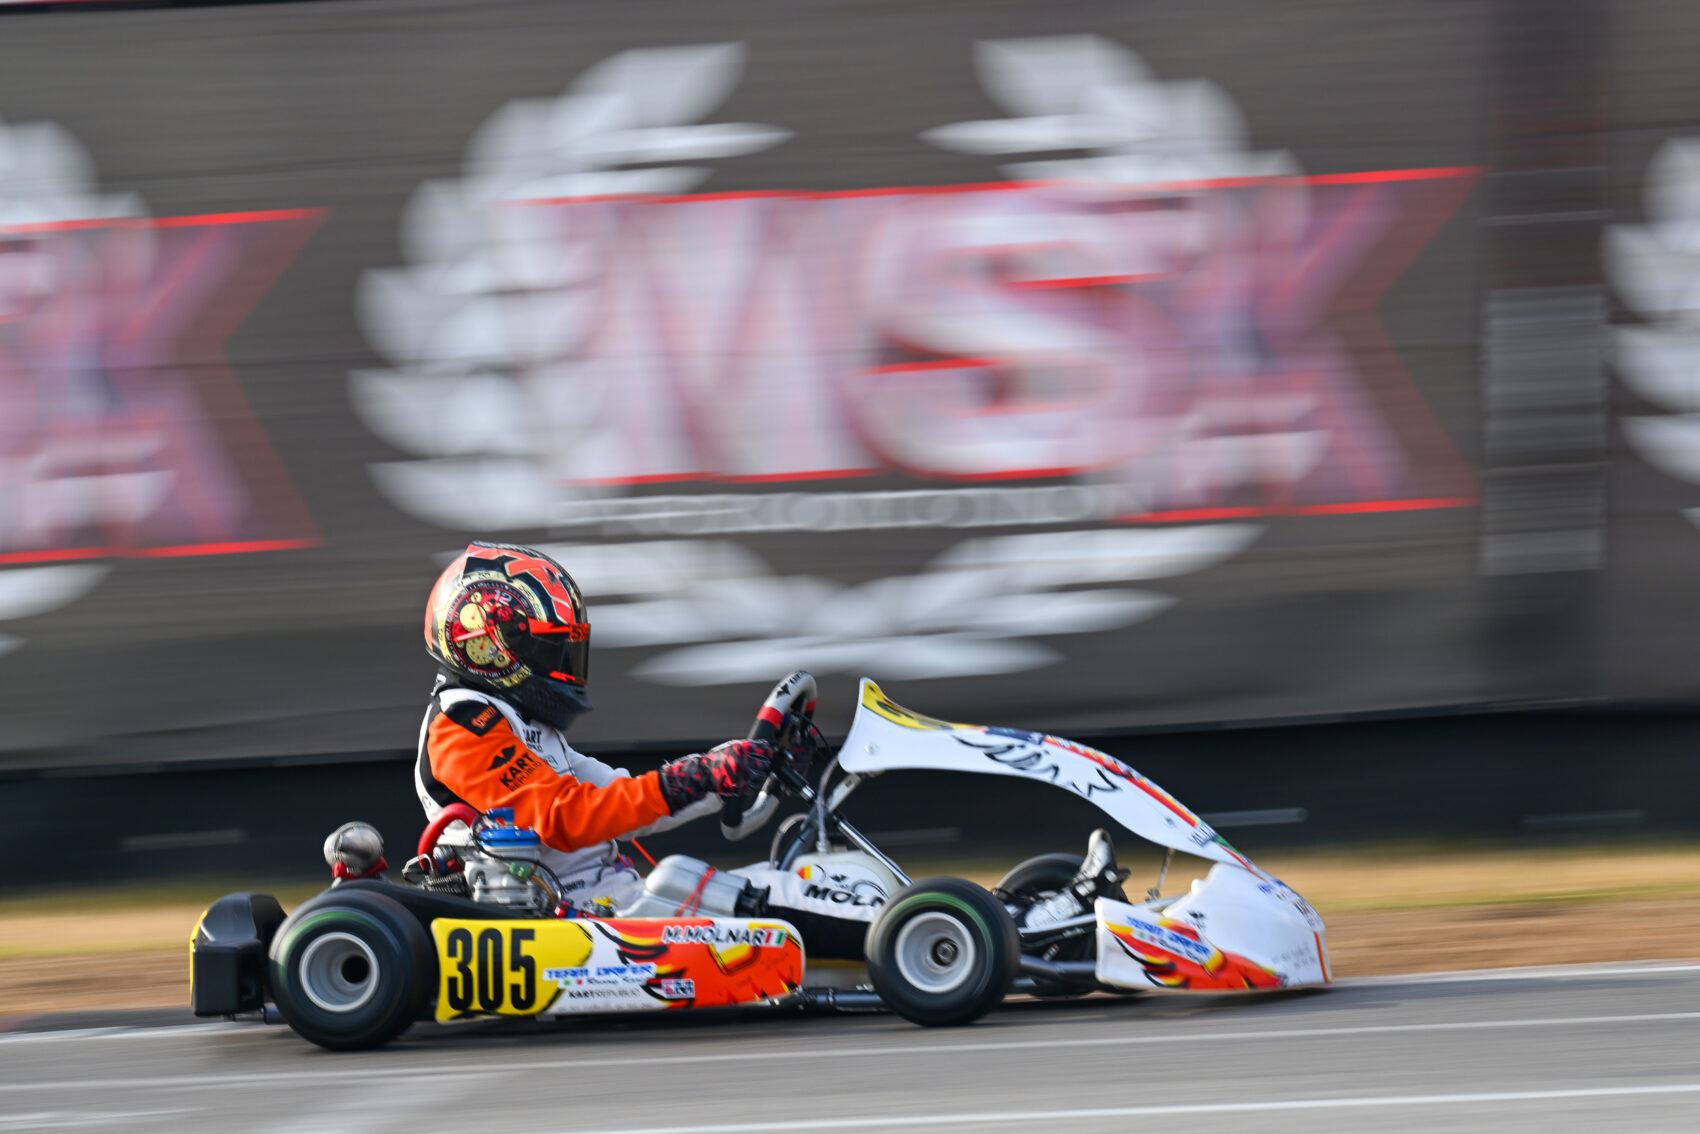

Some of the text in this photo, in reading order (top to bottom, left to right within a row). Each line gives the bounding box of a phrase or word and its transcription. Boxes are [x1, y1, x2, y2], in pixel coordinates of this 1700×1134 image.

[523, 728, 542, 746] ART
[500, 753, 534, 788] KART
[447, 928, 536, 1011] 305
